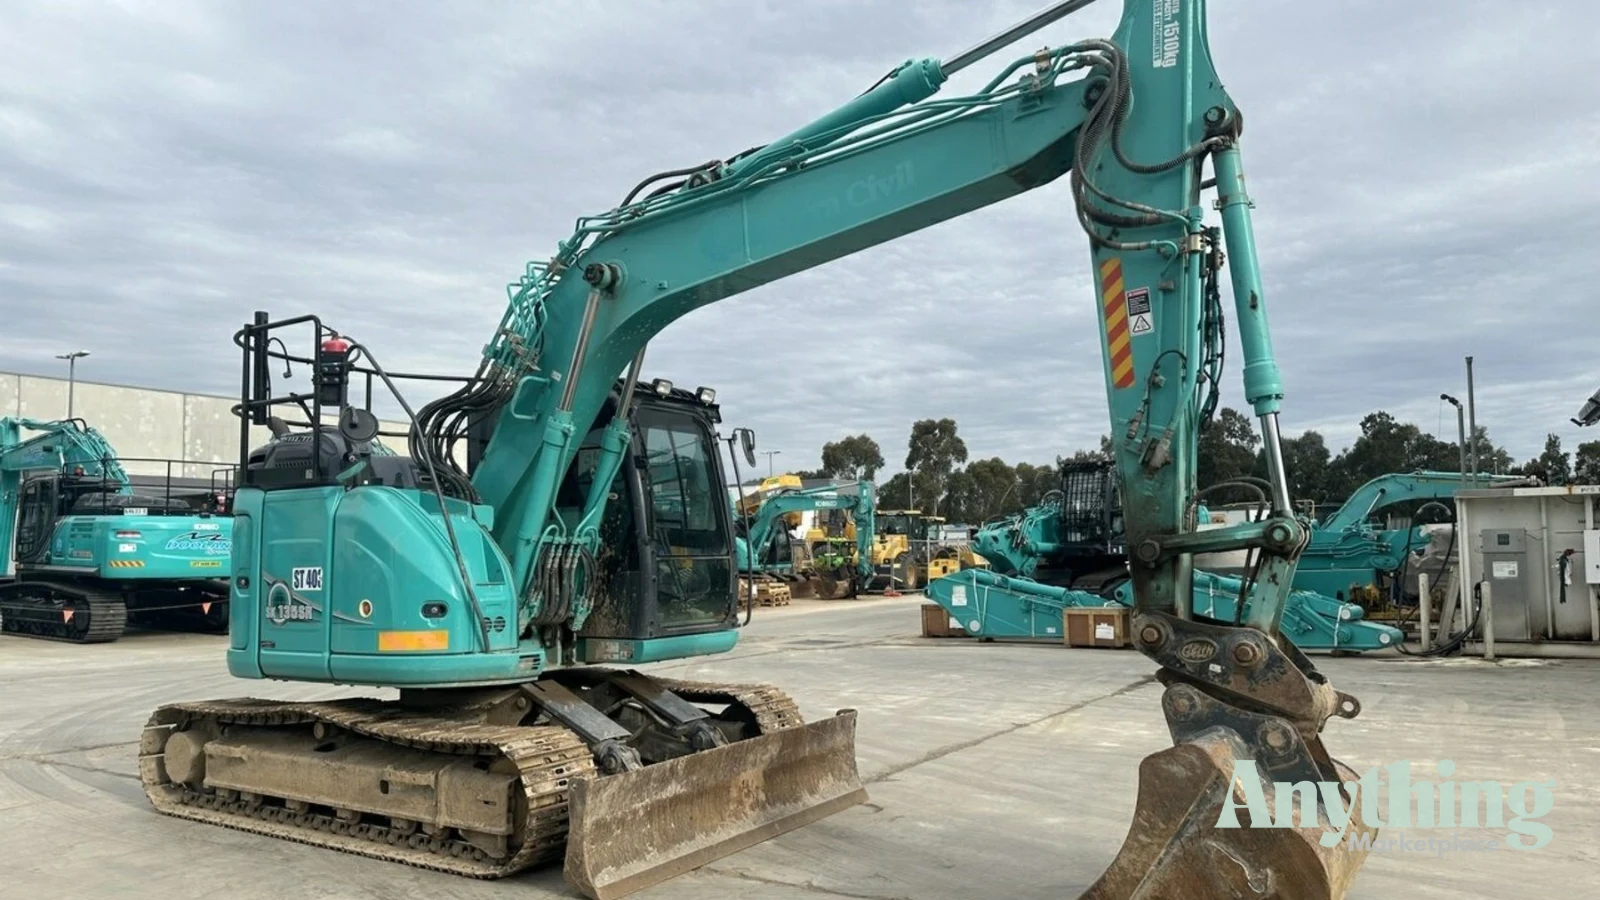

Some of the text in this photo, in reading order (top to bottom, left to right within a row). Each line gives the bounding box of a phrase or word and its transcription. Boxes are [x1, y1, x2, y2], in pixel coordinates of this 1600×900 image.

[1162, 20, 1180, 67] 1510kg
[847, 161, 914, 206] Civil
[293, 569, 305, 589] ST
